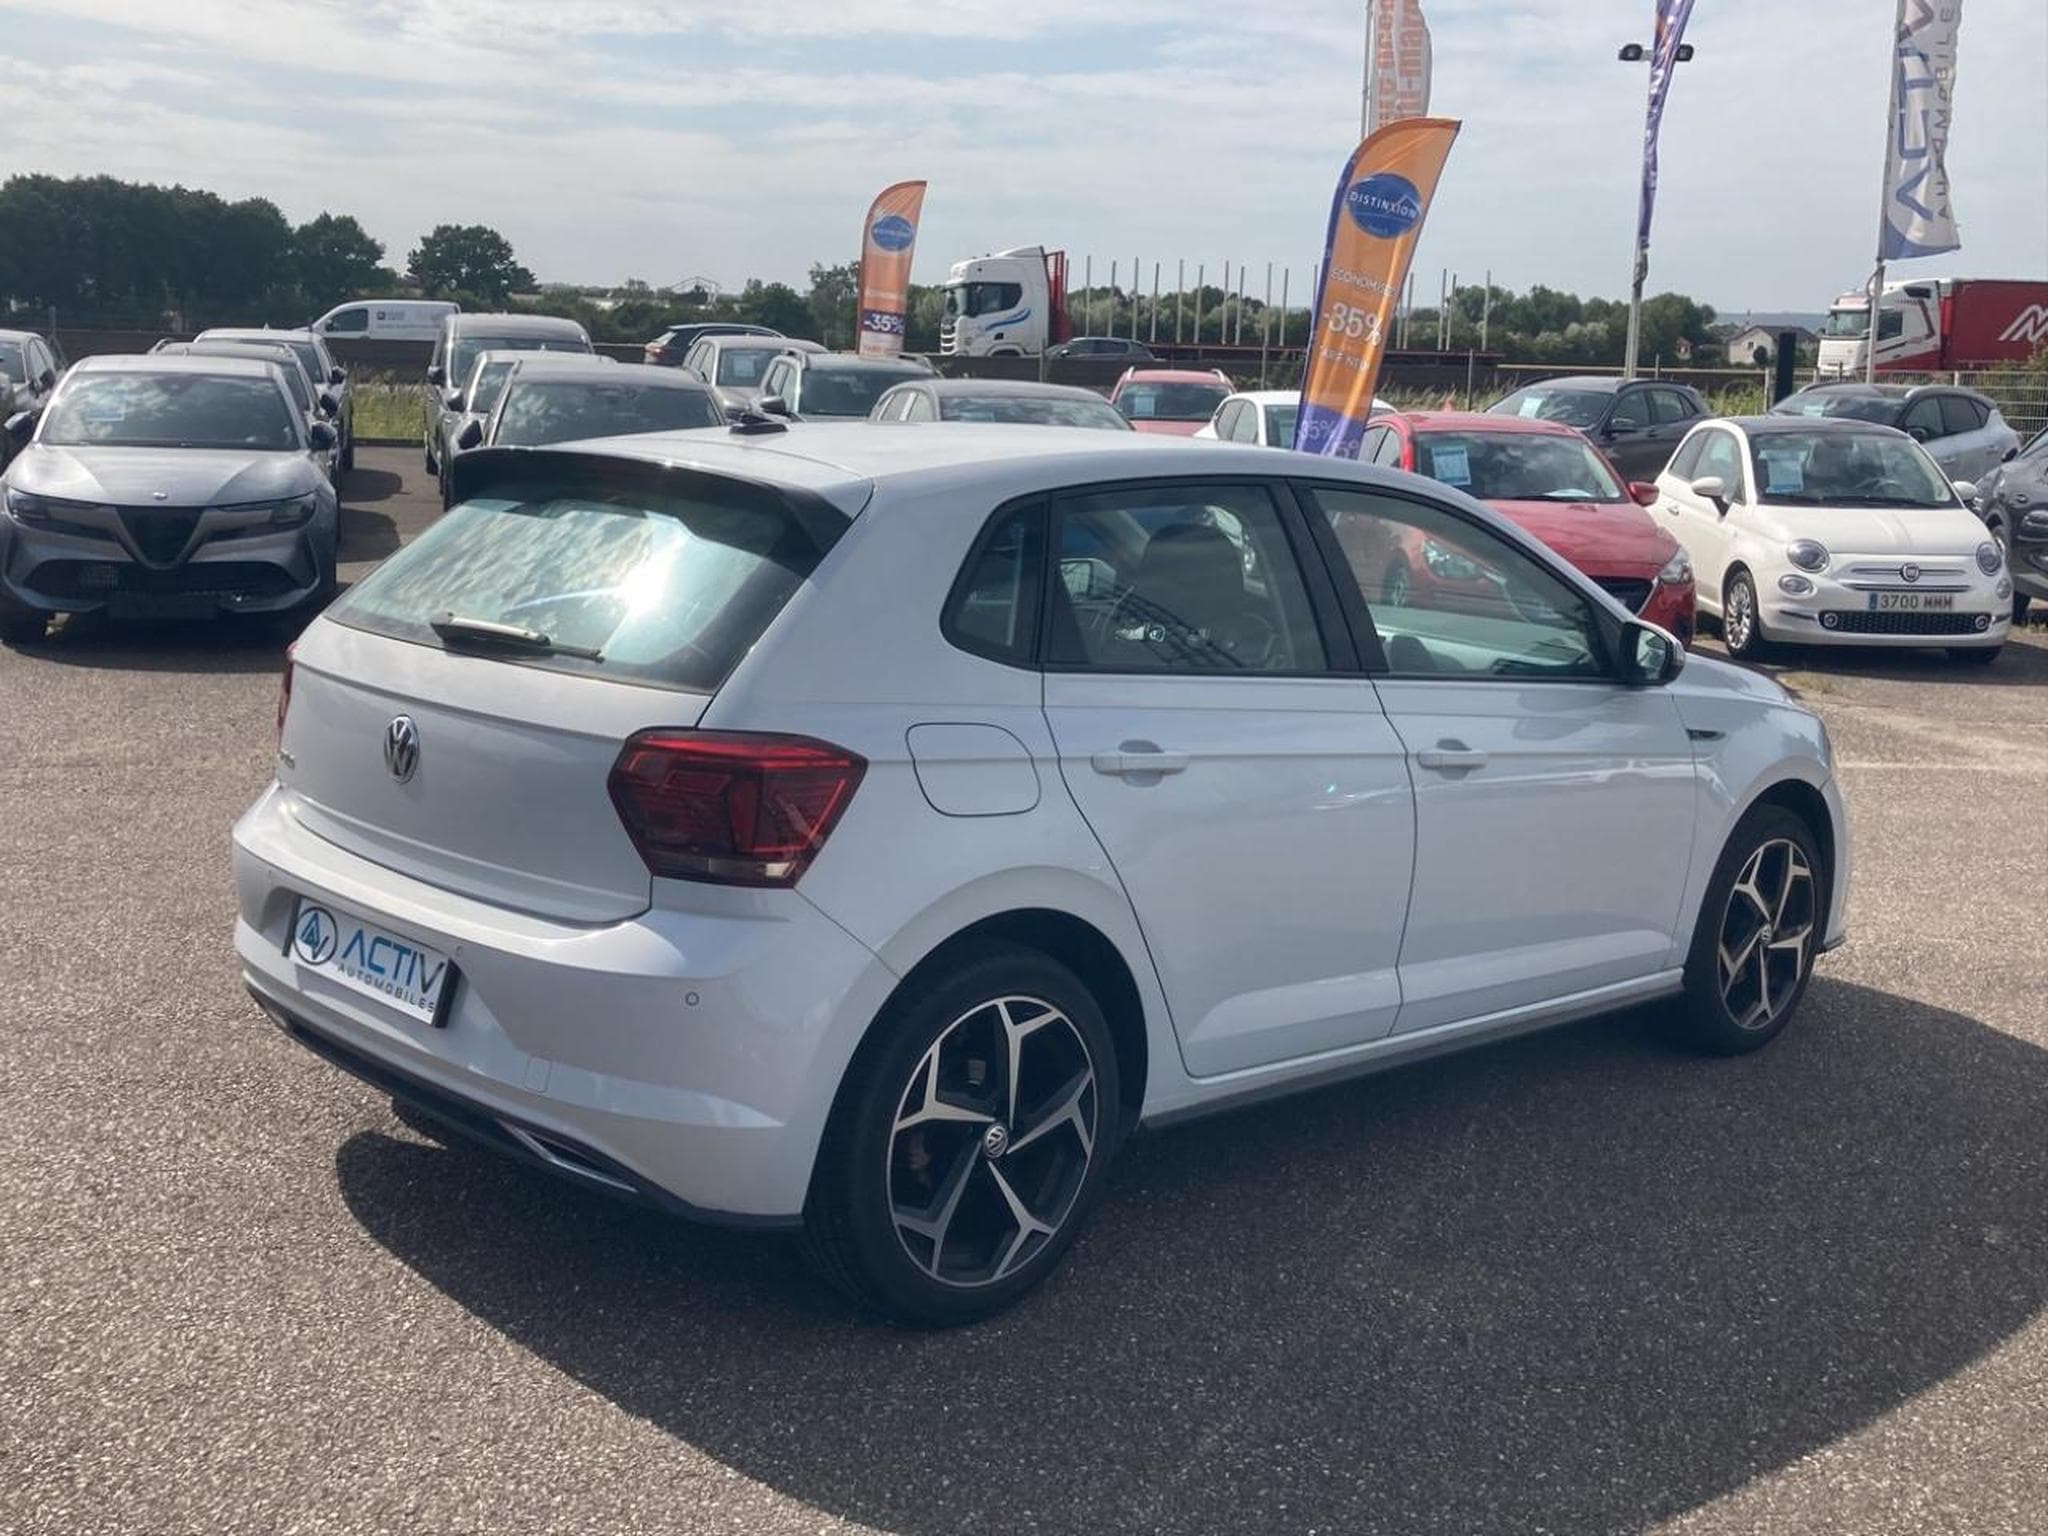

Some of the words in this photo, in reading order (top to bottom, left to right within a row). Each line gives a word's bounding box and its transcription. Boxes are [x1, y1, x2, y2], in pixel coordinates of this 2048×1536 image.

[1348, 188, 1419, 220] DISTINXION
[864, 313, 904, 335] -35%
[1323, 301, 1383, 348] -35%
[1880, 594, 1919, 609] 3700
[341, 928, 445, 995] ACTIV
[337, 964, 436, 1014] AUTOMOBILES
